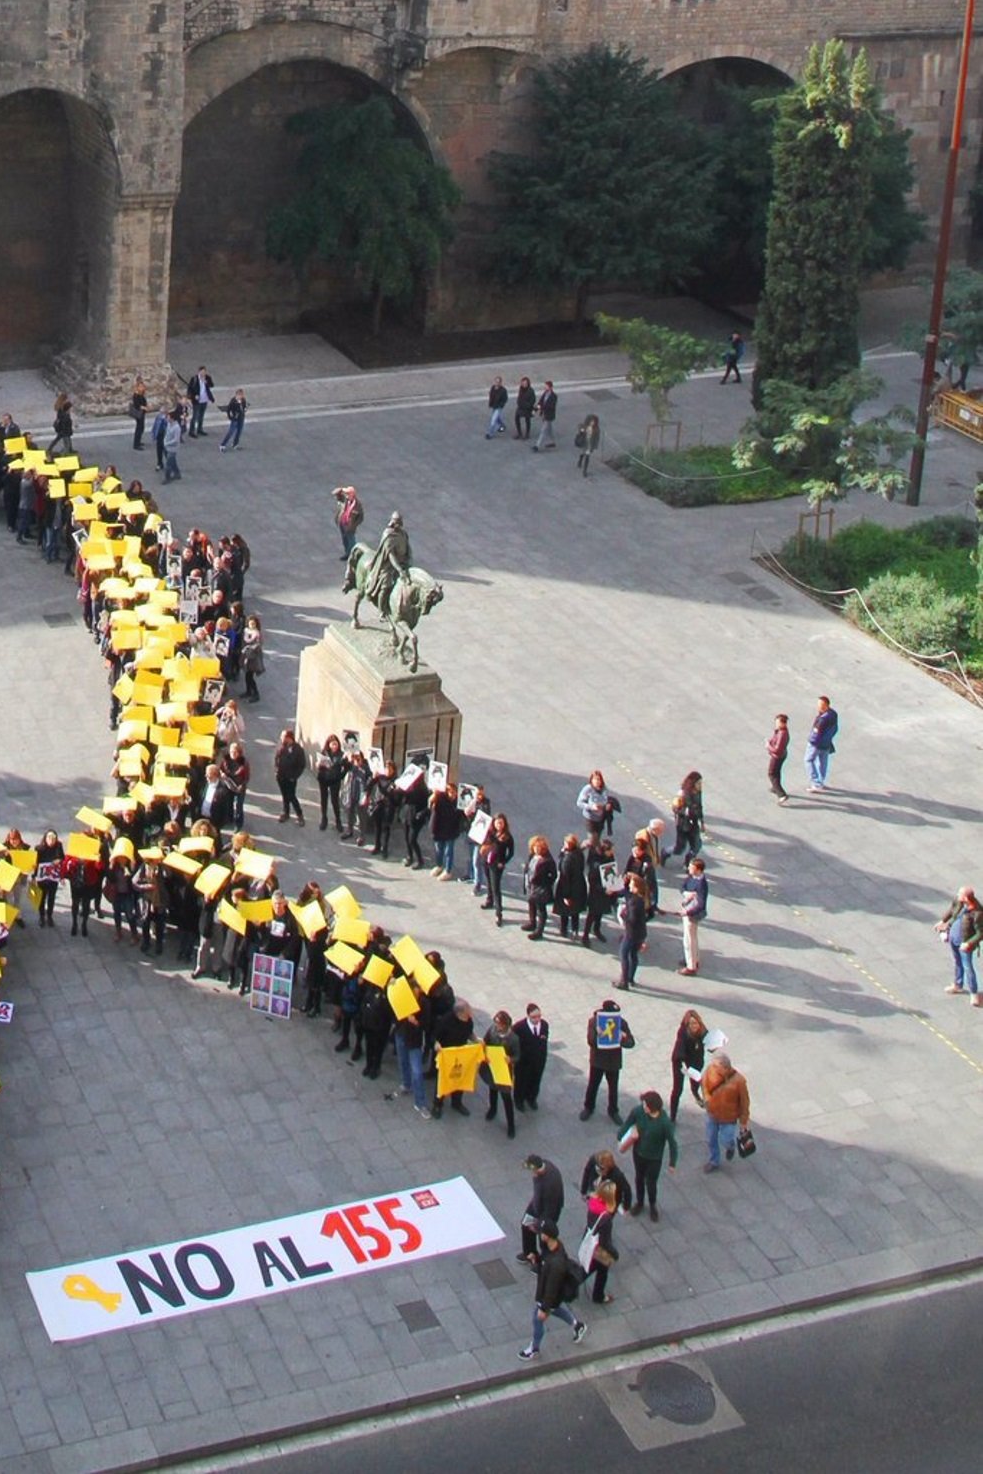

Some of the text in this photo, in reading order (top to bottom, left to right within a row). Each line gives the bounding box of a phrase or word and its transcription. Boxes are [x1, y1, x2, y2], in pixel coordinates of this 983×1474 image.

[117, 1199, 422, 1315] NO AL 155
